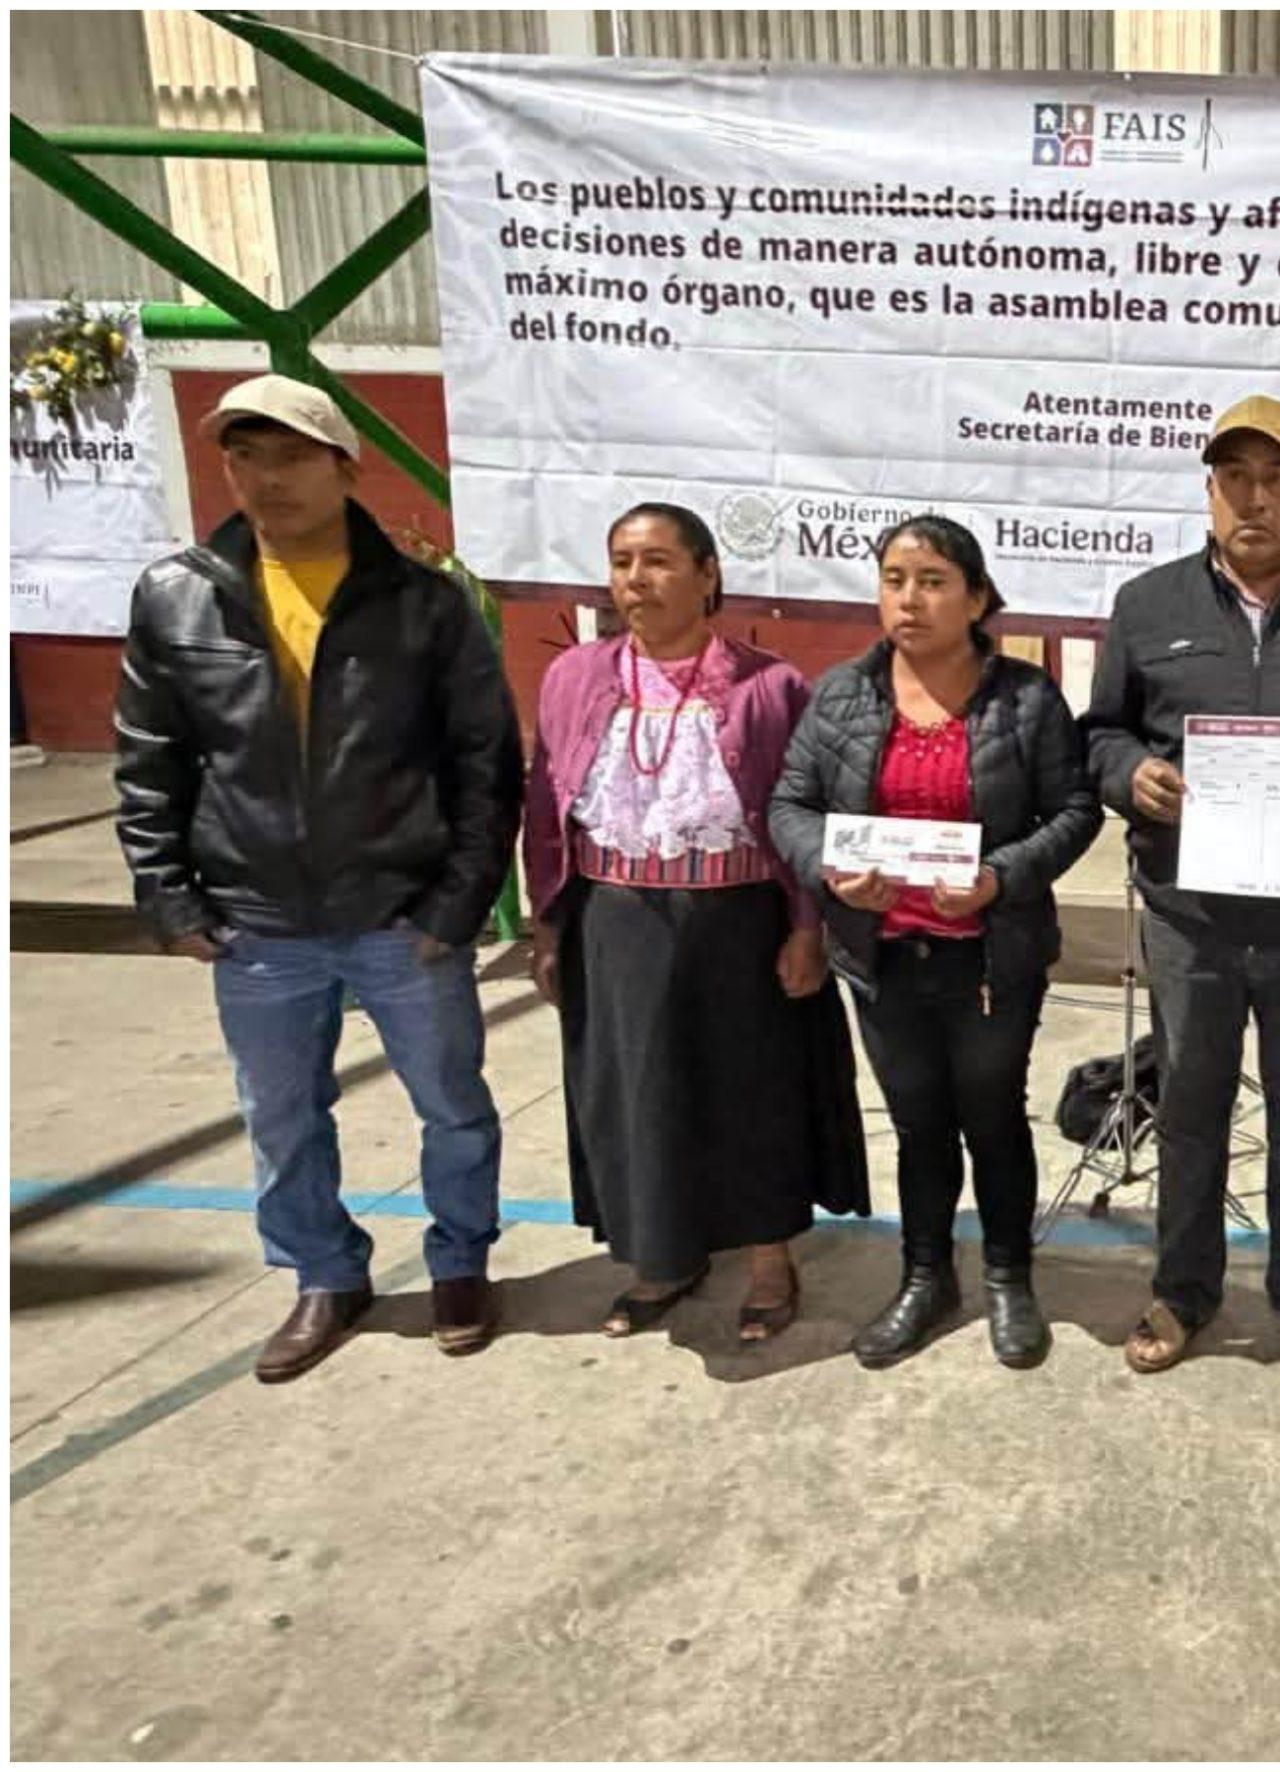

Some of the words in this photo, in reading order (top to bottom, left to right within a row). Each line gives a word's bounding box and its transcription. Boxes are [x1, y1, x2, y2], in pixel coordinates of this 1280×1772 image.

[1103, 111, 1187, 142] FAIS
[495, 171, 558, 204] Los
[571, 176, 706, 216] pueblos
[716, 186, 737, 220] y
[750, 184, 996, 220] comunidades
[1009, 188, 1196, 232] indígenas
[1208, 202, 1231, 236] y
[499, 218, 686, 258] decisiones
[701, 228, 743, 261] de
[759, 235, 898, 265] manera
[914, 237, 1118, 278] autónoma,
[1135, 241, 1222, 276] libre
[1238, 252, 1261, 287] y
[505, 265, 649, 302] máximo
[662, 274, 796, 315] órgano,
[810, 285, 876, 319] que
[889, 287, 928, 314] es
[942, 283, 974, 315] la
[988, 287, 1168, 323] asamblea
[510, 310, 557, 341] del
[1023, 390, 1213, 421] Atentamente
[957, 416, 1100, 445] Secretaría
[1107, 423, 1142, 448] de
[1150, 425, 1210, 450] Bien
[796, 499, 913, 526] Gobierno
[796, 521, 885, 561] Méx
[995, 518, 1154, 554] Hacienda
